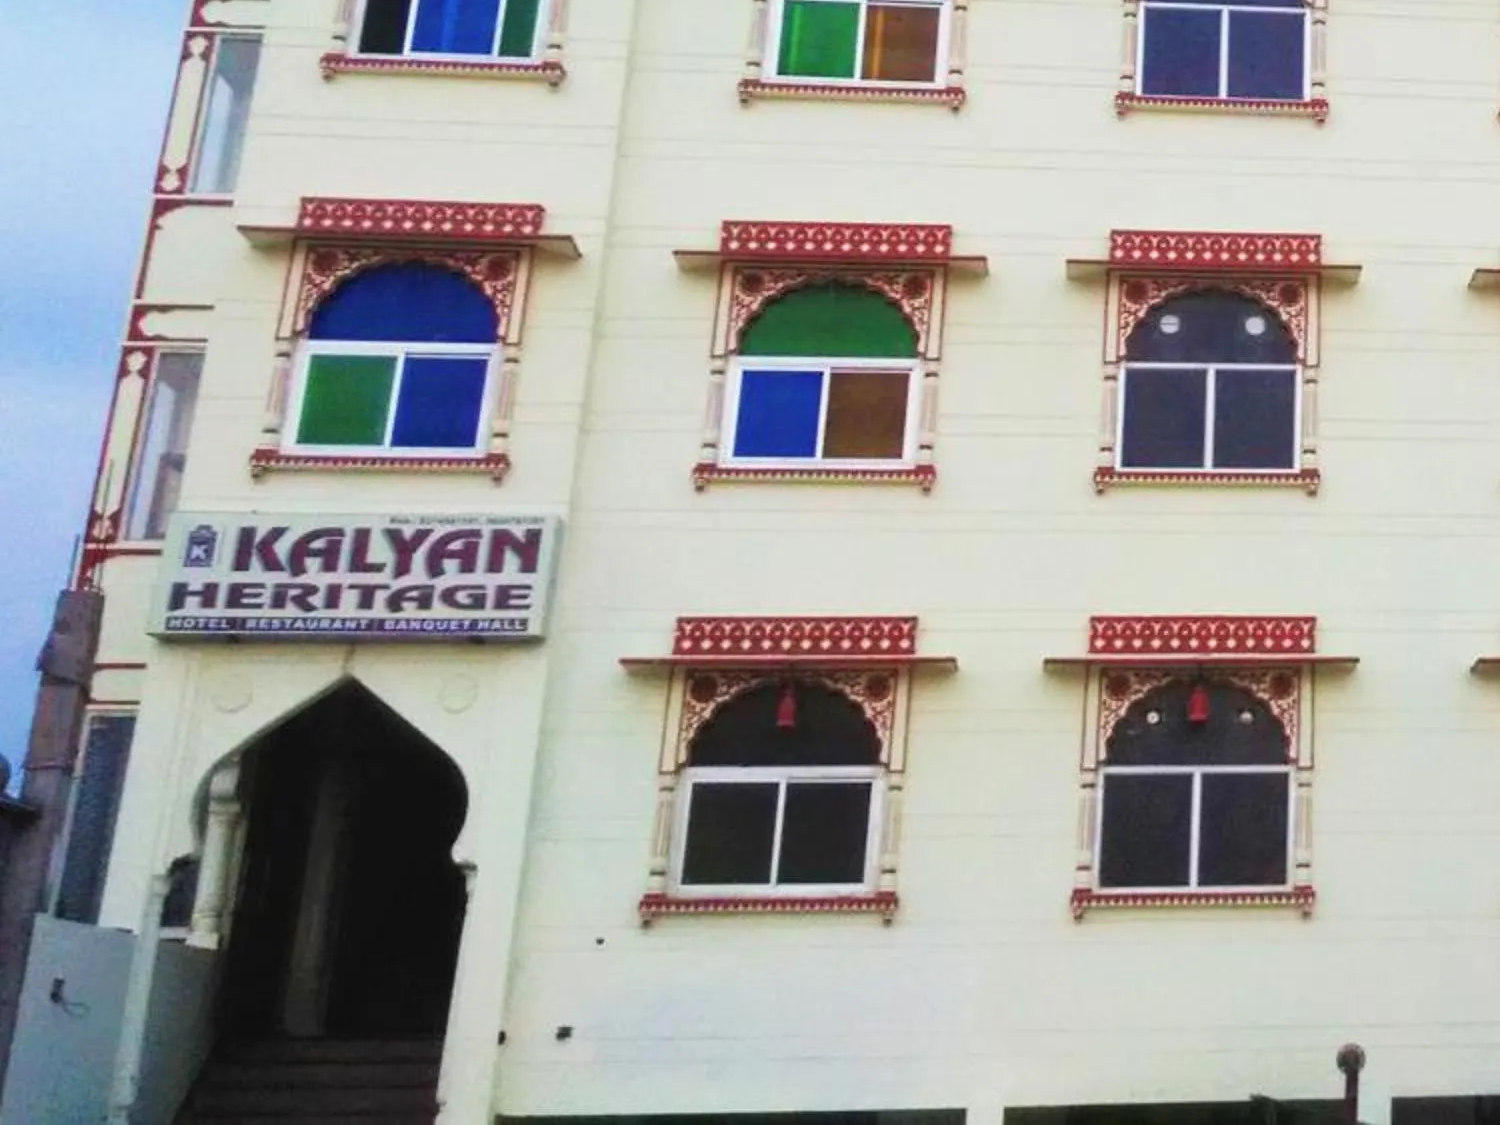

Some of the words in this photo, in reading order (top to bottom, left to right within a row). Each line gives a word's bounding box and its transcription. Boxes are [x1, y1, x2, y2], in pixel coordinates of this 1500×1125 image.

[233, 526, 543, 579] KALYAN
[167, 582, 533, 613] HERITAGE
[168, 618, 230, 630] HOTEL
[245, 618, 370, 631] RESTAURANT
[383, 619, 473, 632] BANQUET
[476, 619, 527, 631] HALL
